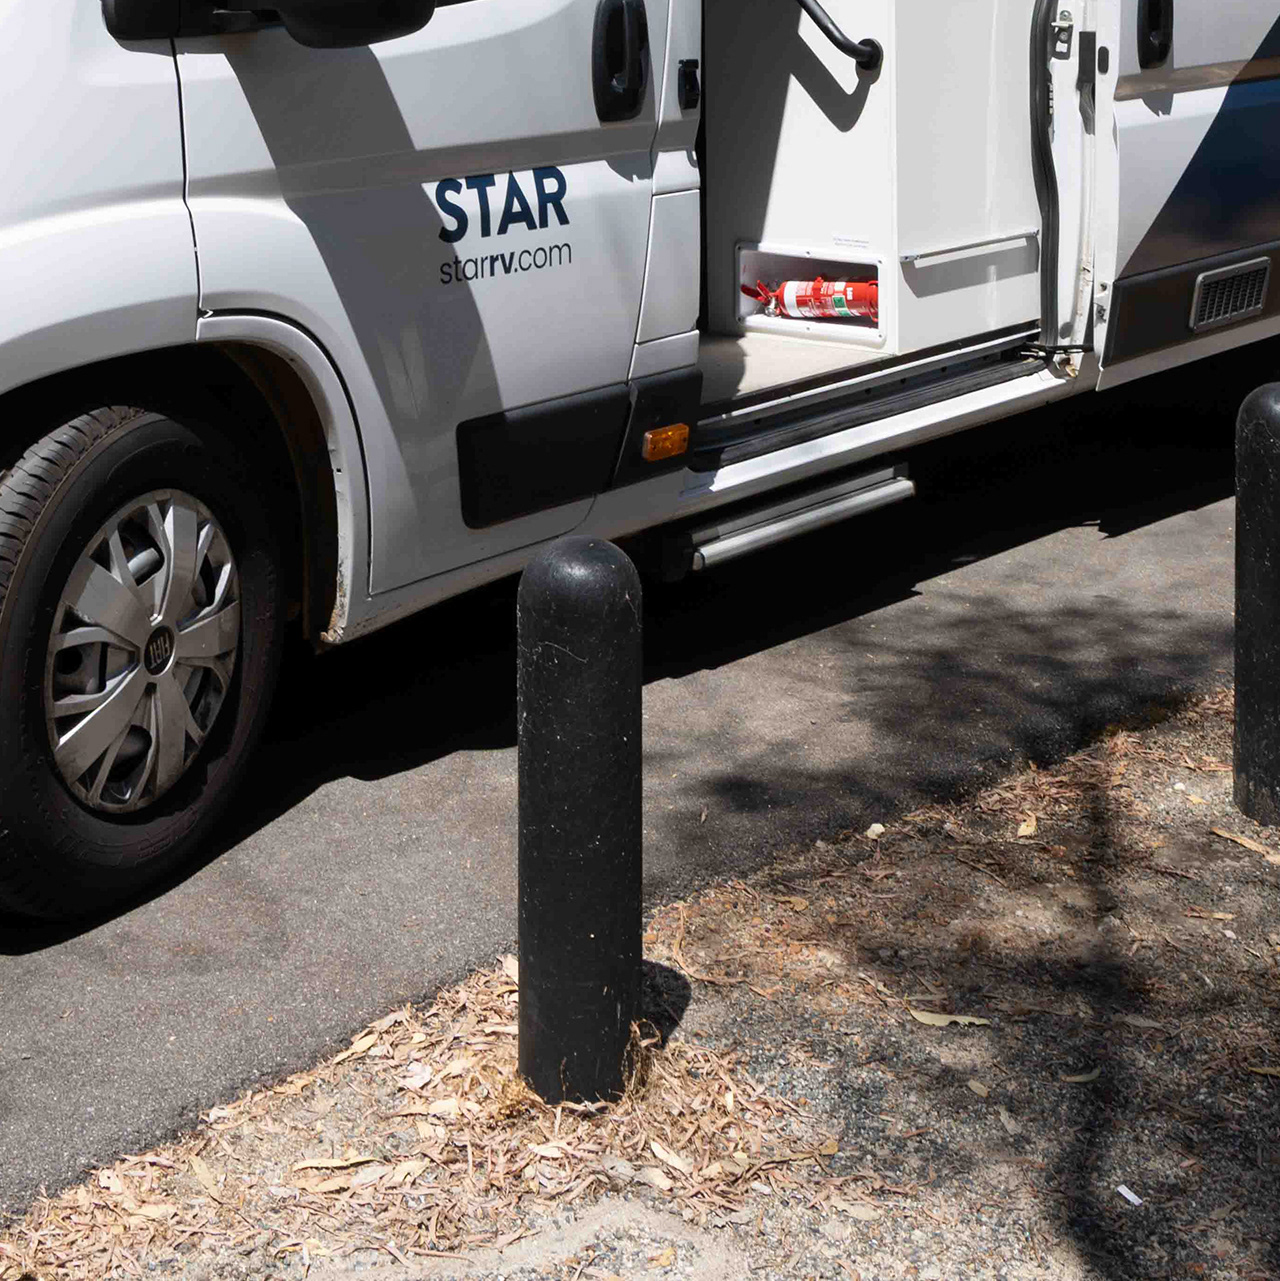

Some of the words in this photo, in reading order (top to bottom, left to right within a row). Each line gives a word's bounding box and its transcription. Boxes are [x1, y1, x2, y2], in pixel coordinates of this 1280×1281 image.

[435, 165, 570, 244] STAR
[439, 242, 572, 285] starrv.com
[149, 631, 171, 669] FIAT
